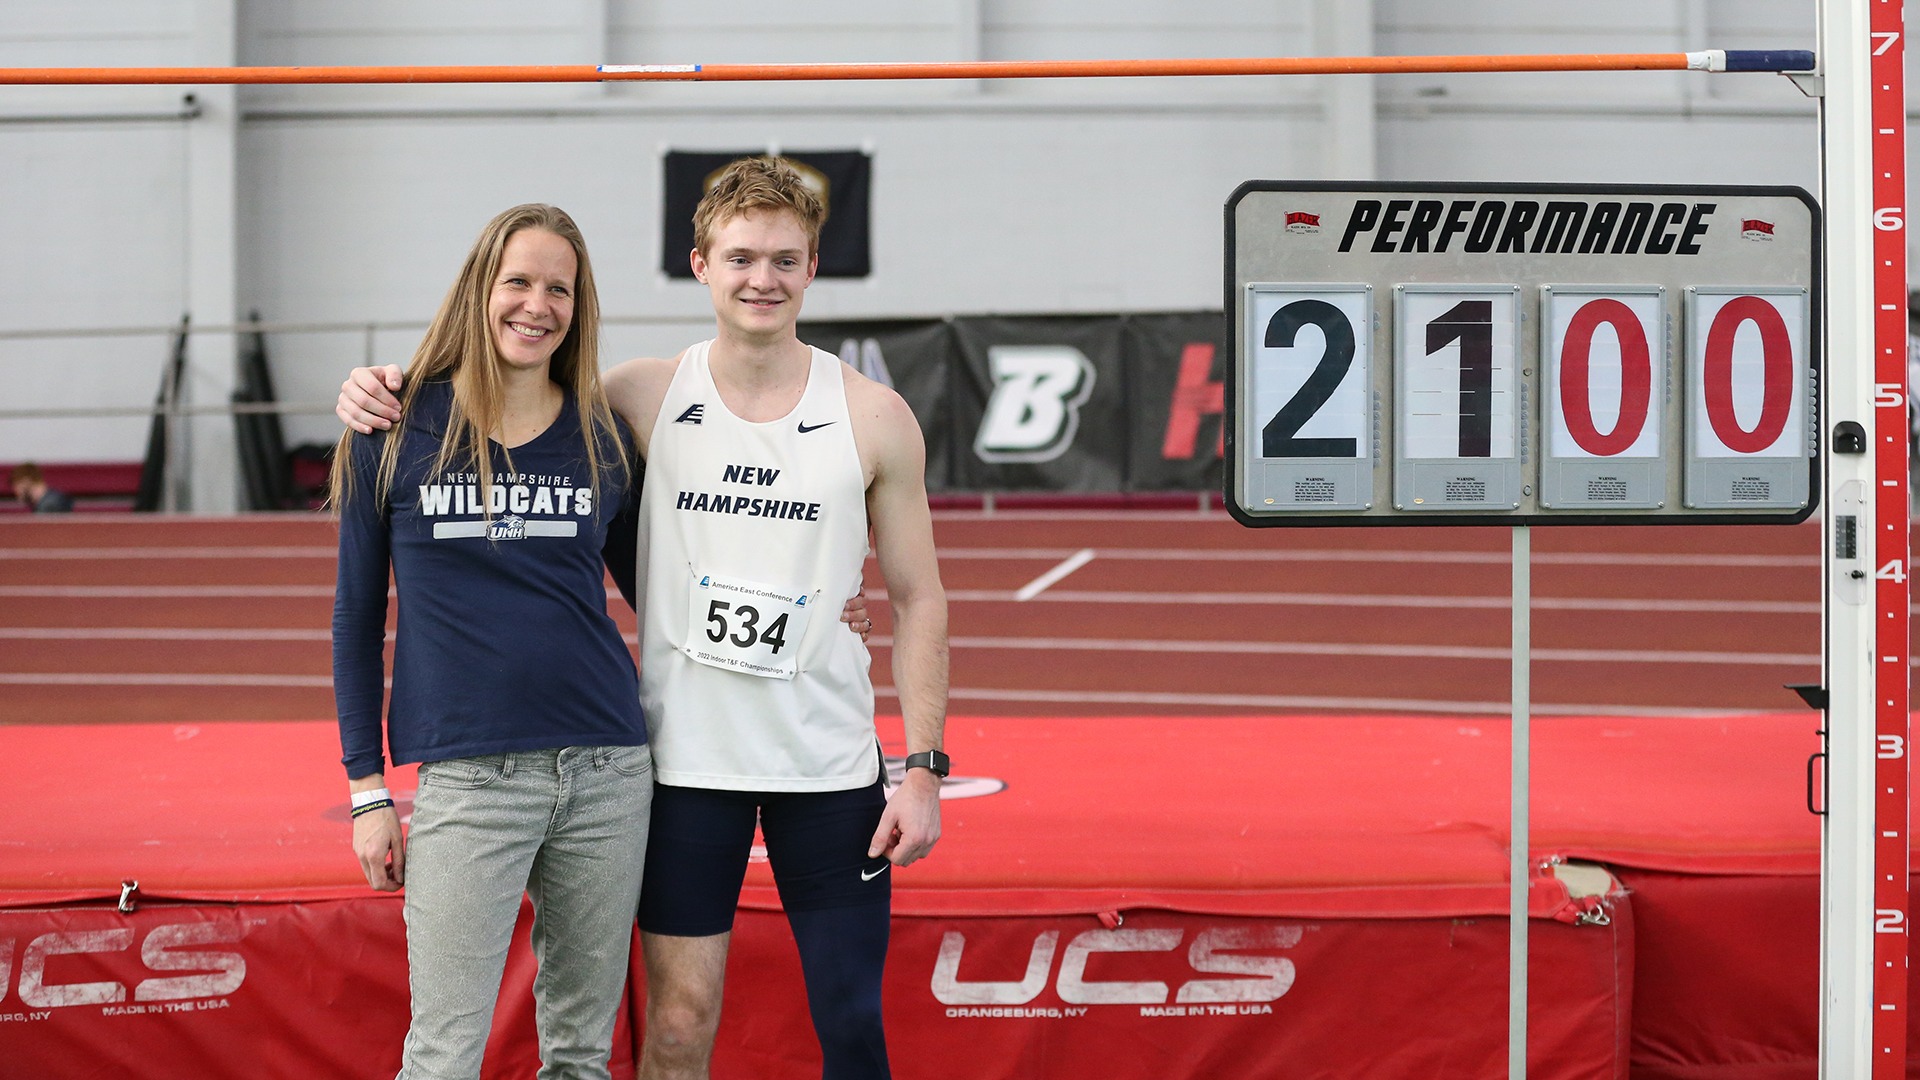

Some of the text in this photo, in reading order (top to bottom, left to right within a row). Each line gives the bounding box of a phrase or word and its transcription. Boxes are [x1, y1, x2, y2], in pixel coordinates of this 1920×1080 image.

[1871, 32, 1900, 55] 7
[1338, 200, 1718, 255] PERFORMANCE
[1873, 207, 1904, 231] 6
[1875, 383, 1904, 407] 5
[447, 473, 570, 486] NEW AMPSHIRE
[722, 464, 780, 486] NEW
[419, 485, 592, 516] WILDCATS
[676, 491, 821, 522] HAMPSHIRE
[490, 527, 522, 538] UNH
[1876, 560, 1906, 583] 4
[712, 582, 738, 592] America
[756, 590, 793, 602] Conference
[706, 599, 789, 655] 534
[697, 652, 709, 660] 2022
[711, 655, 726, 663] Indoor
[740, 661, 783, 674] Championships
[1877, 735, 1904, 759] 3
[1876, 909, 1904, 932] 2
[930, 926, 1303, 1005] UCS
[0, 1011, 51, 1022] RG, NY
[102, 999, 229, 1016] MADE IN THE USA
[945, 1008, 1087, 1019] ORANGEBURG, NY
[1140, 1004, 1272, 1017] MADE IN THE USA
